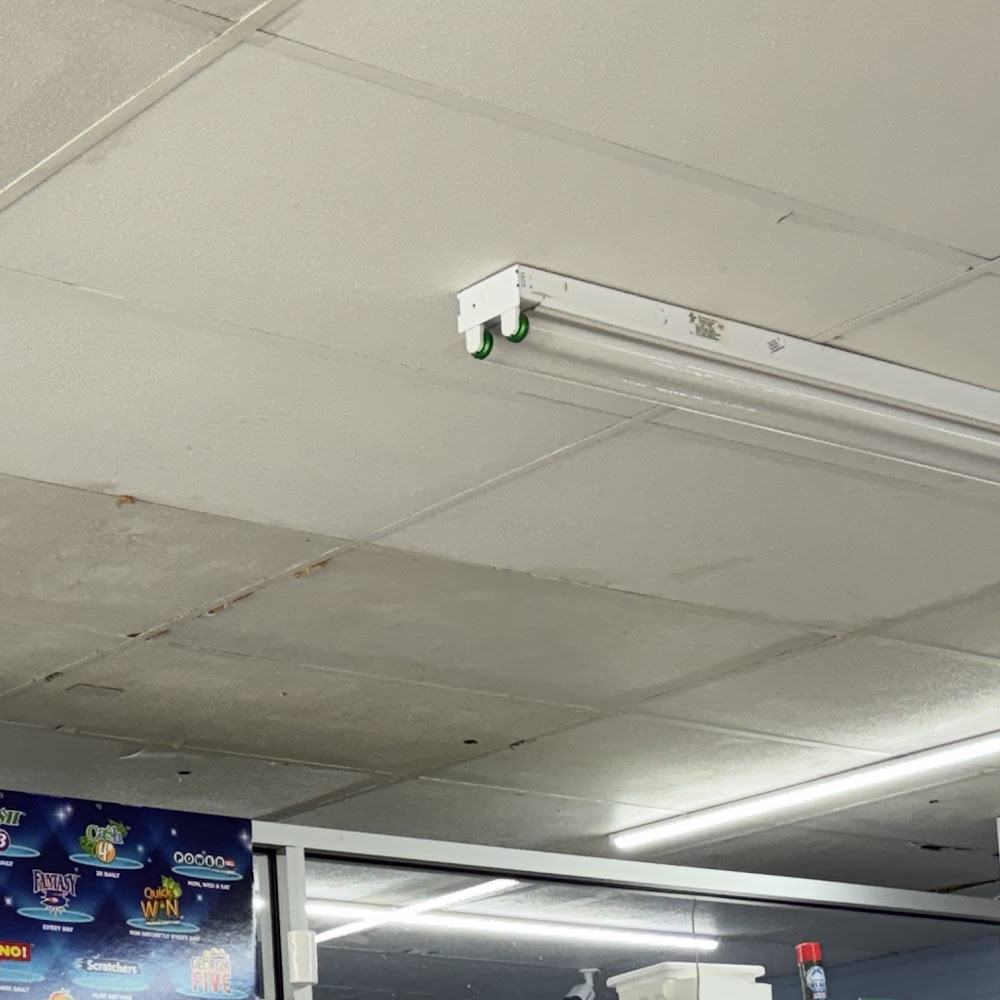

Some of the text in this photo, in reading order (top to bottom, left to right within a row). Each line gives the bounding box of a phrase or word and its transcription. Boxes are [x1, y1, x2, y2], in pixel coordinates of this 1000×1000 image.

[32, 868, 79, 897] FANTASY
[86, 959, 138, 974] Scratchers
[191, 970, 232, 994] FIVE
